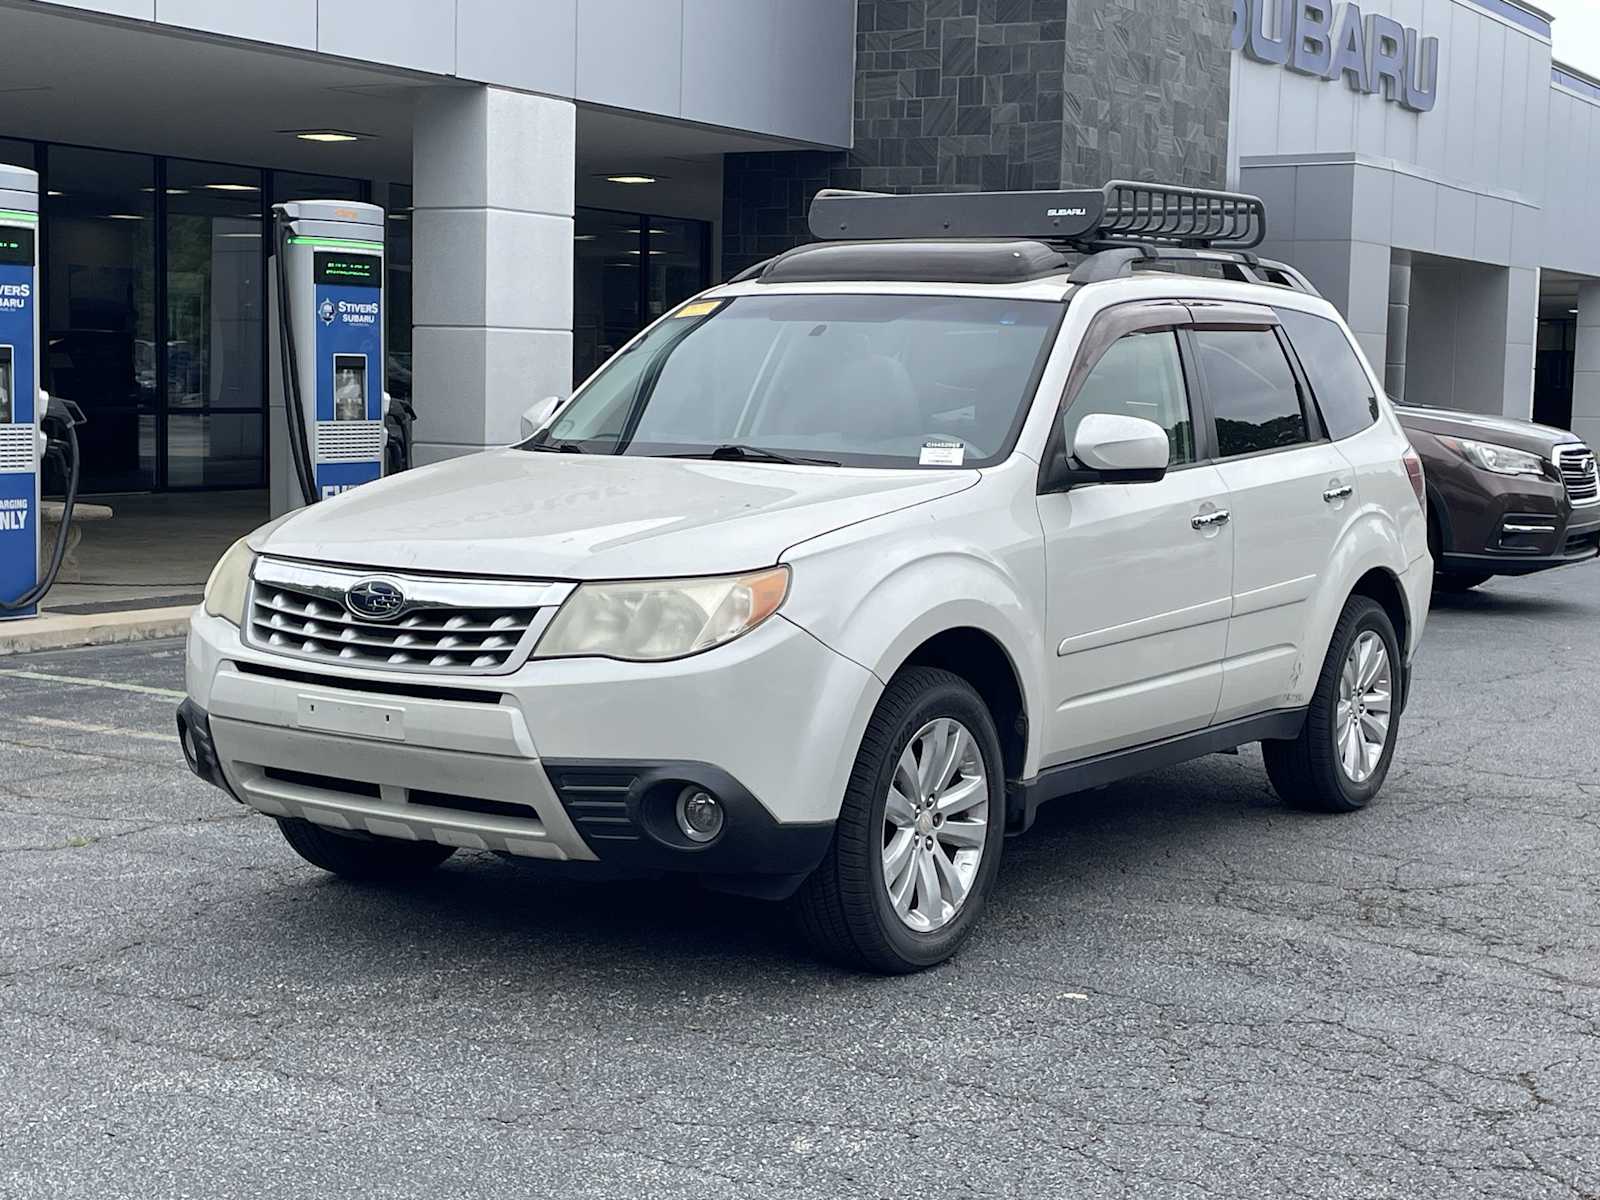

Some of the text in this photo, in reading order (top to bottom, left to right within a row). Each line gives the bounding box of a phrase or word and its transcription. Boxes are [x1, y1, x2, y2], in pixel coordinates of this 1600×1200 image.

[1047, 208, 1086, 216] SUBARU
[342, 313, 375, 323] SUBARU
[0, 510, 28, 530] NLY
